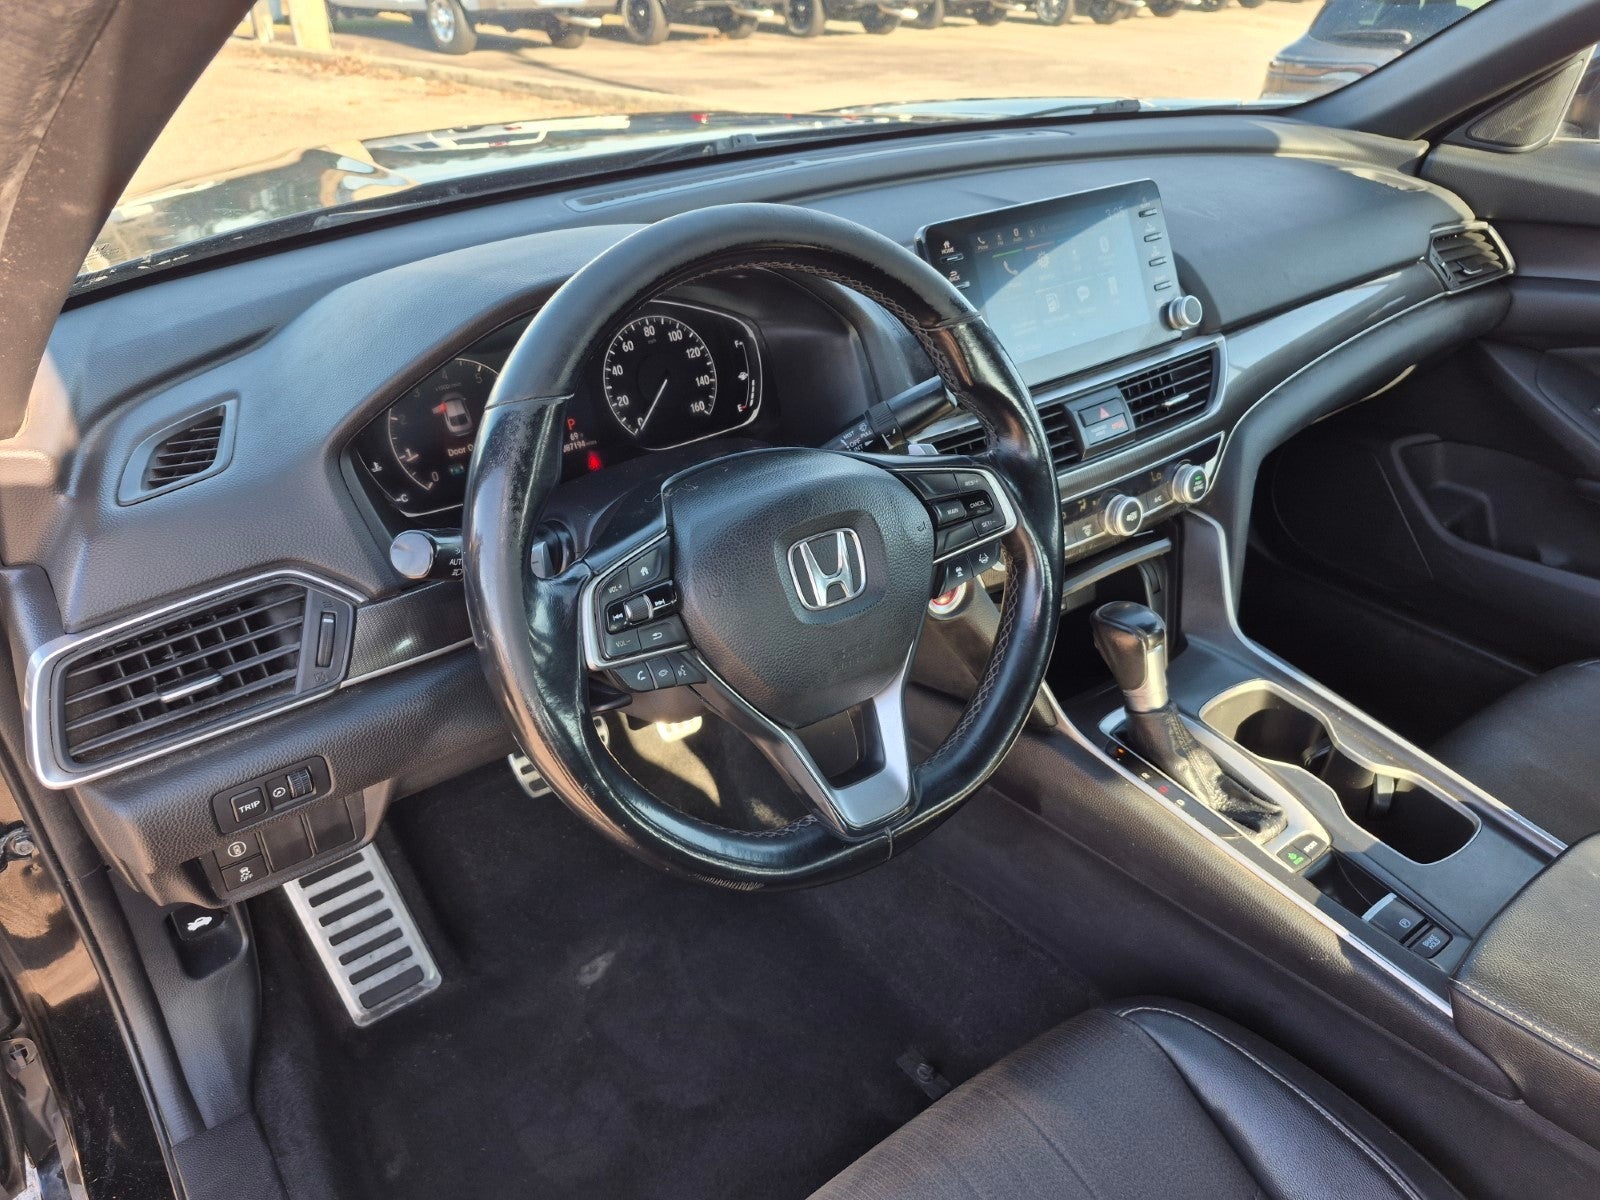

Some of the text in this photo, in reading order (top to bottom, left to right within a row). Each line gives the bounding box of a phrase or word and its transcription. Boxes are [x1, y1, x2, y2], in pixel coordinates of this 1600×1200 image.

[643, 325, 656, 337] 80
[667, 330, 683, 342] 100
[622, 340, 635, 352] 60
[686, 348, 701, 359] 120
[612, 364, 624, 377] 40
[695, 375, 710, 387] 140
[616, 395, 629, 407] 20
[690, 401, 705, 413] 160
[567, 418, 576, 430] P
[850, 437, 861, 447] OFF
[448, 447, 466, 456] Door
[431, 471, 440, 482] 0
[238, 800, 261, 813] TRIP
[240, 873, 254, 882] OFF
